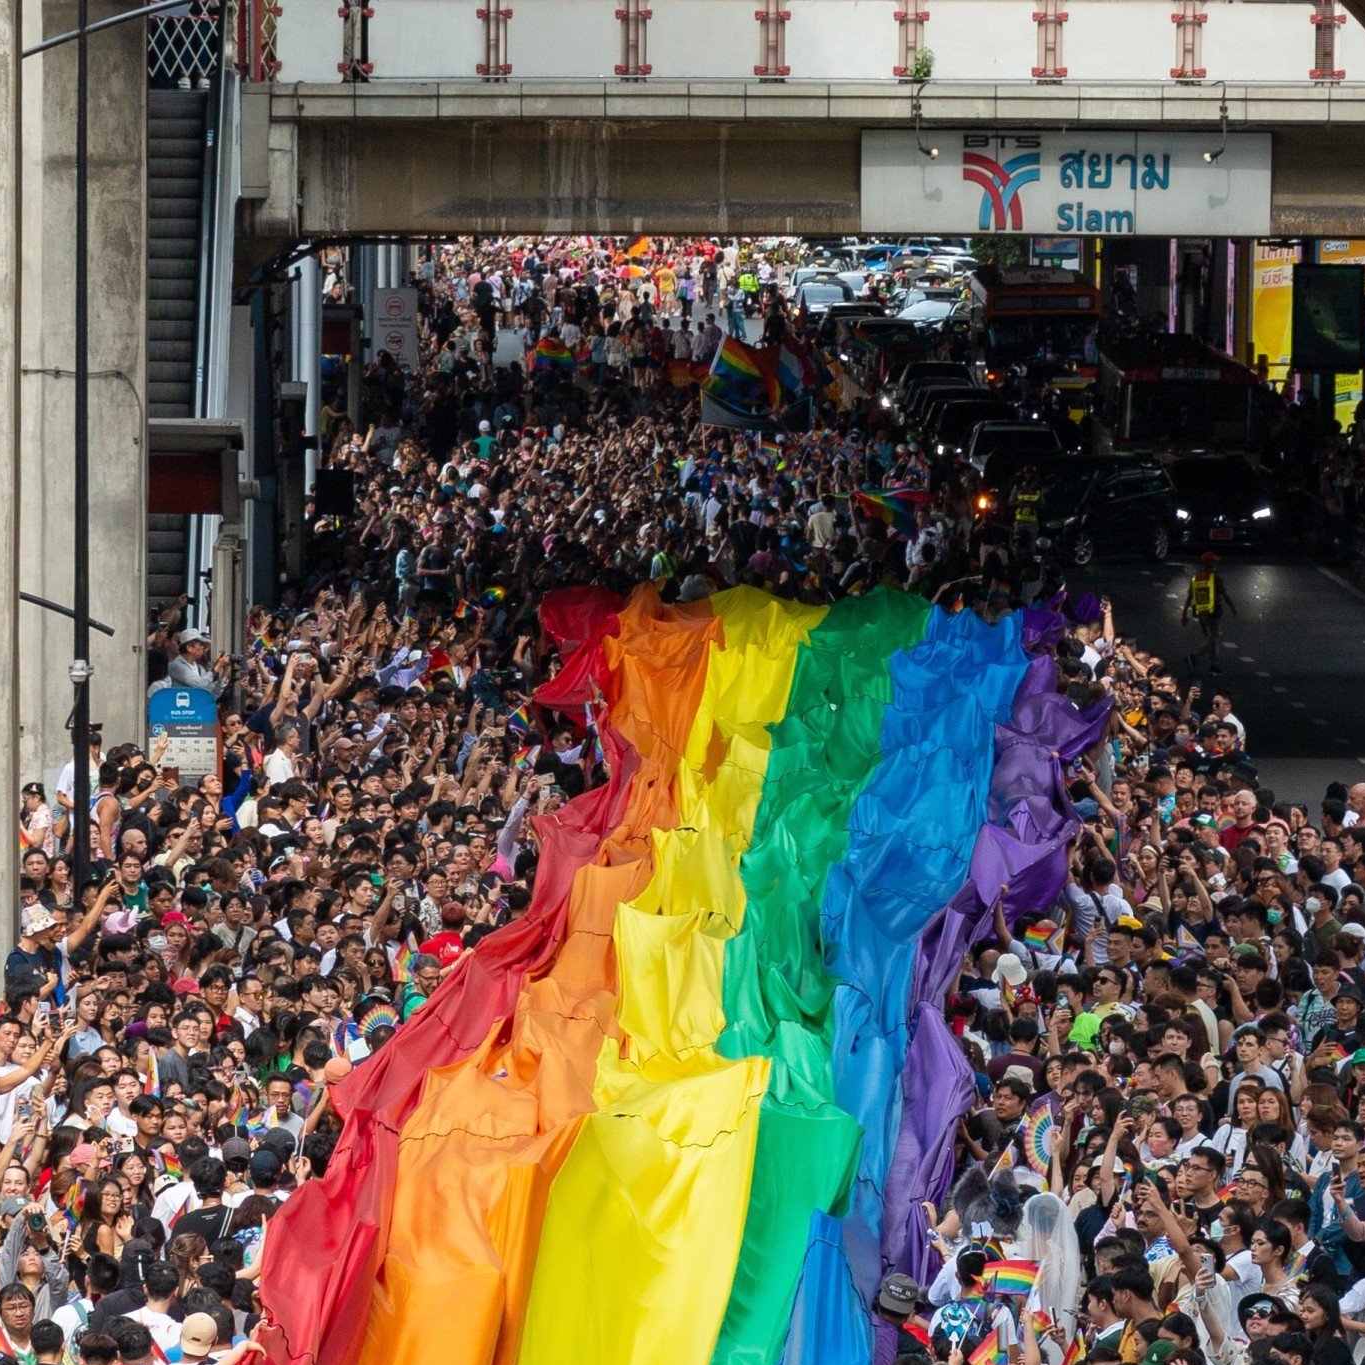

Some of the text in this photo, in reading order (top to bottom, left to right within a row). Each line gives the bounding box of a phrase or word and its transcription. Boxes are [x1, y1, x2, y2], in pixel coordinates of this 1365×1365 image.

[963, 135, 1041, 148] BTS
[1058, 150, 1171, 190] สยาม
[1057, 204, 1133, 233] Siam
